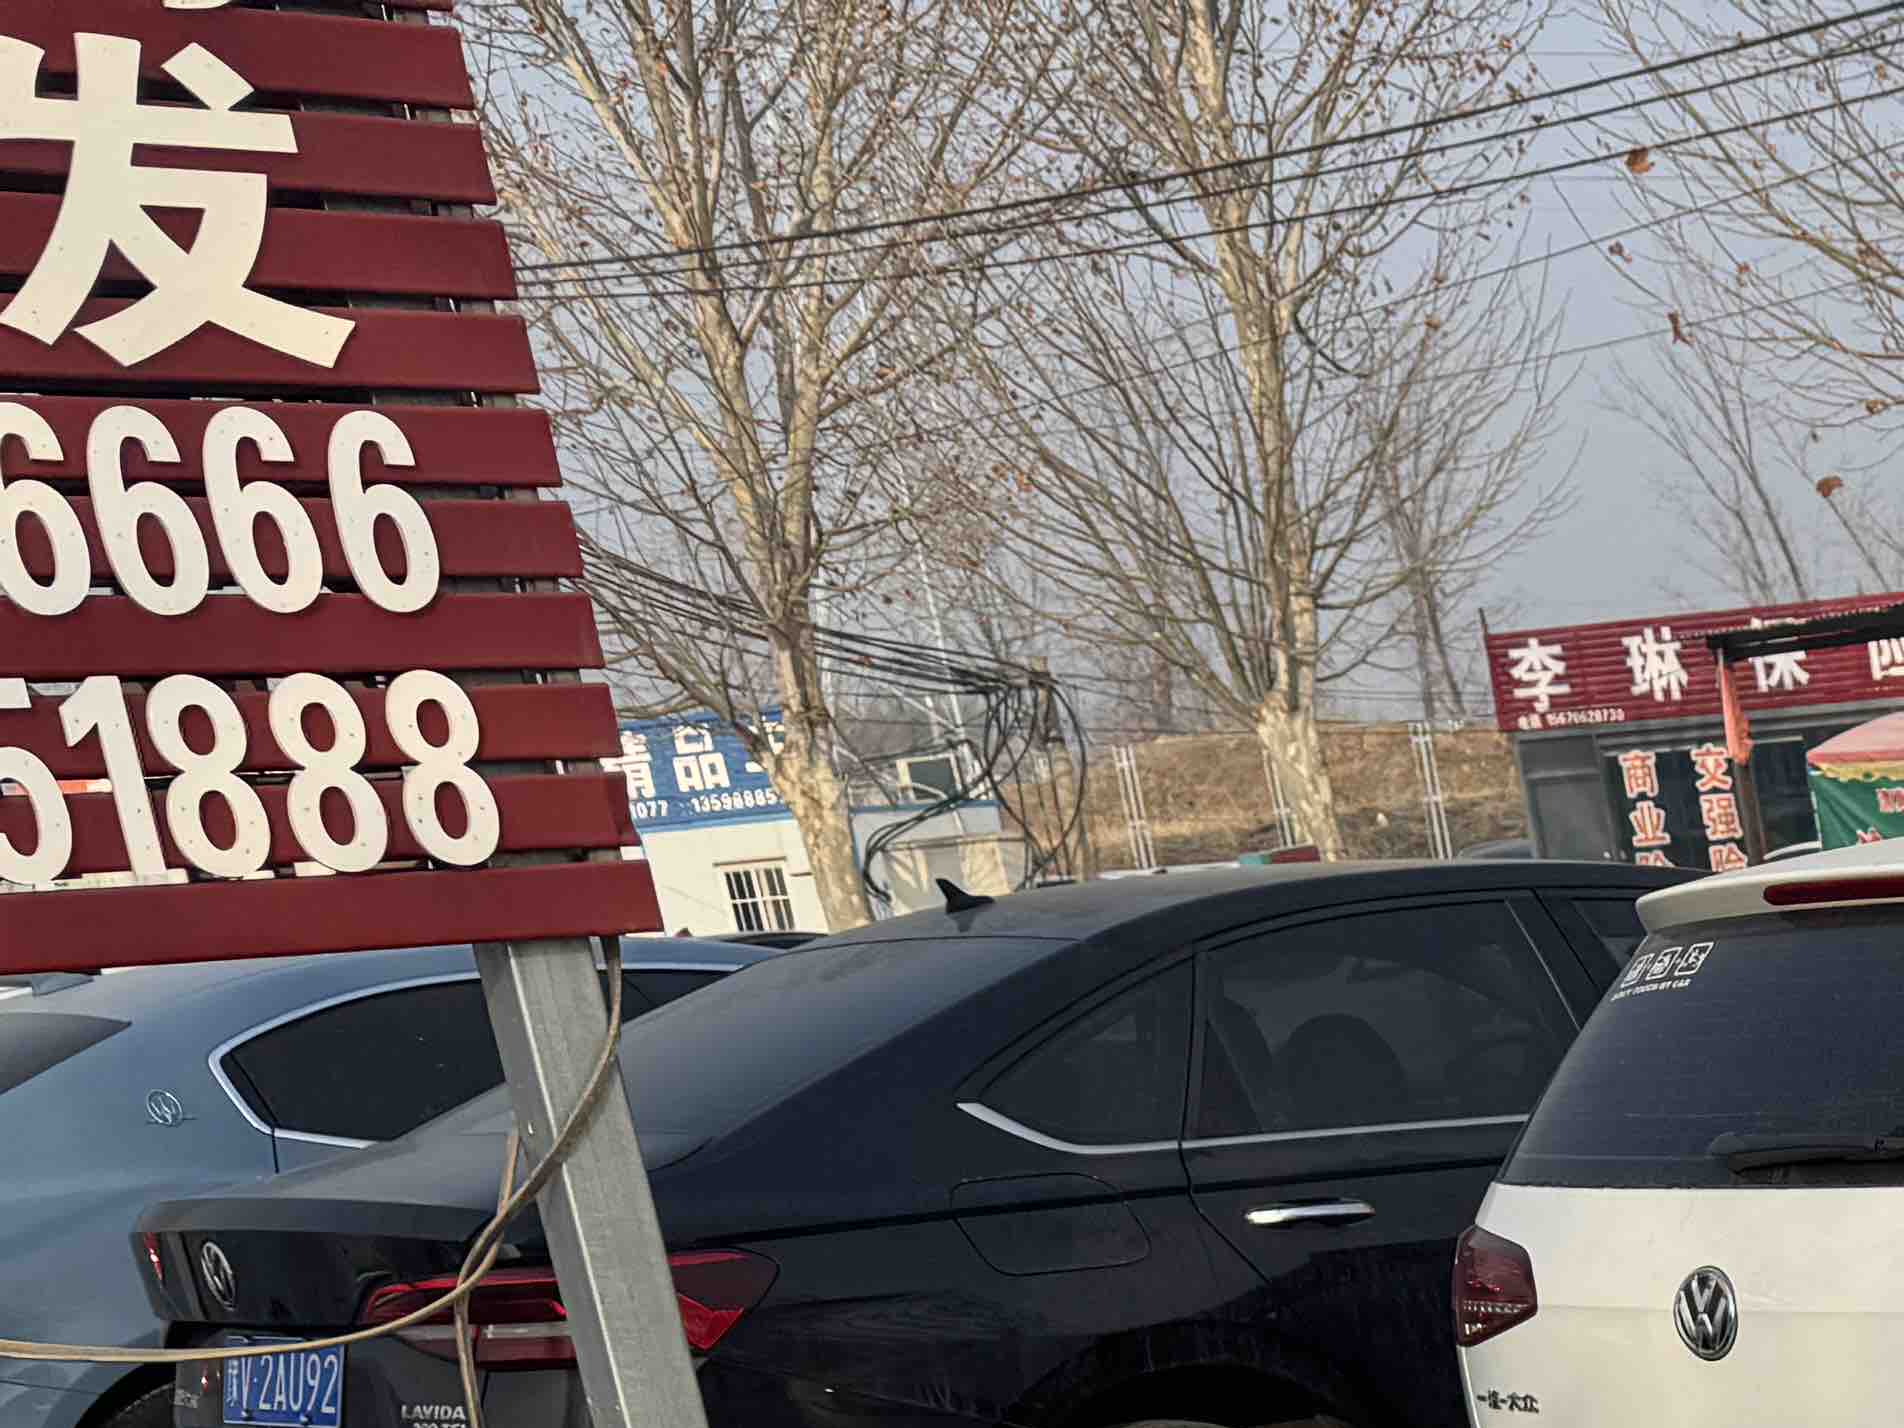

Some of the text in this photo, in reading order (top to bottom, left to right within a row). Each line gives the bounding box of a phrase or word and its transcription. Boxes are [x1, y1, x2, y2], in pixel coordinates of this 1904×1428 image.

[0, 33, 355, 368] 发
[0, 670, 500, 885] 51888
[401, 1404, 466, 1421] LAVIDA
